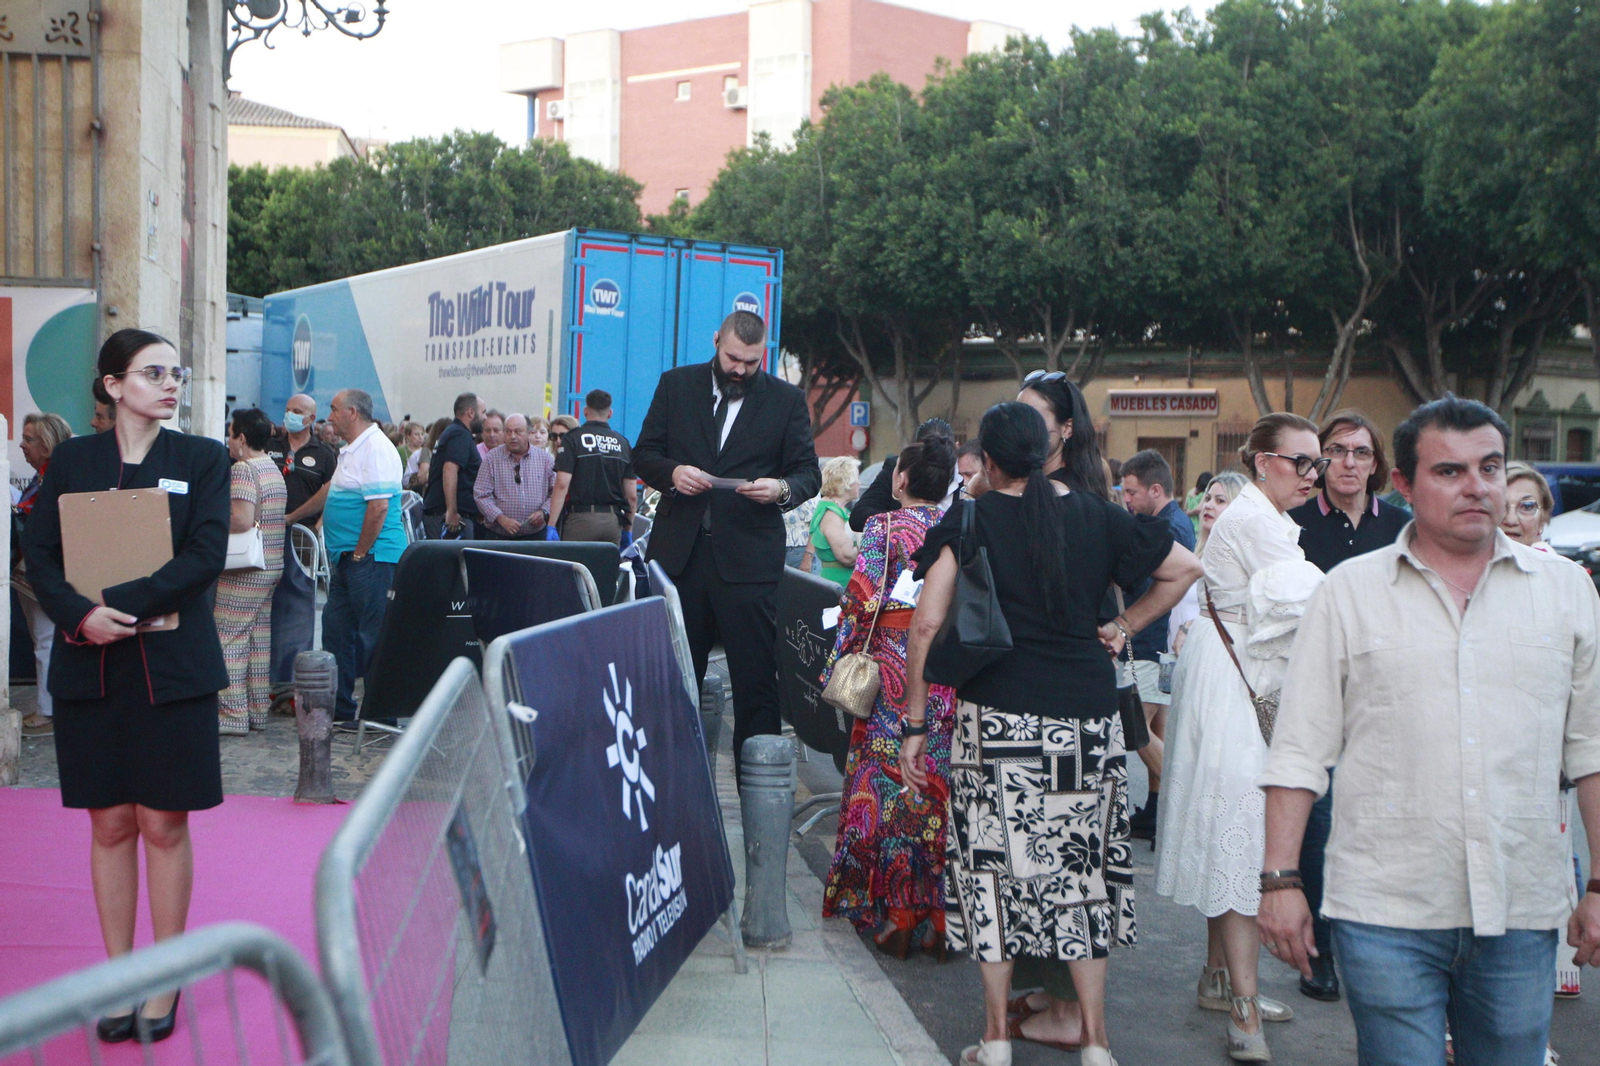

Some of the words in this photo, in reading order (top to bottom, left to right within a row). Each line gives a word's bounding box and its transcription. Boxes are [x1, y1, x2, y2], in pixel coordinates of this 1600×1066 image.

[594, 288, 618, 304] TWT
[428, 291, 455, 338] The
[457, 281, 493, 337] Wild
[496, 281, 536, 330] Tour
[294, 340, 311, 370] TWT
[438, 363, 517, 380] thewildtour@thewildtour.com
[1110, 396, 1167, 411] MUEBLES
[1169, 396, 1217, 411] CASADO
[854, 405, 866, 424] P
[595, 434, 618, 445] grupo
[597, 442, 622, 453] control
[632, 924, 655, 967] RADIO
[651, 919, 659, 943] Y
